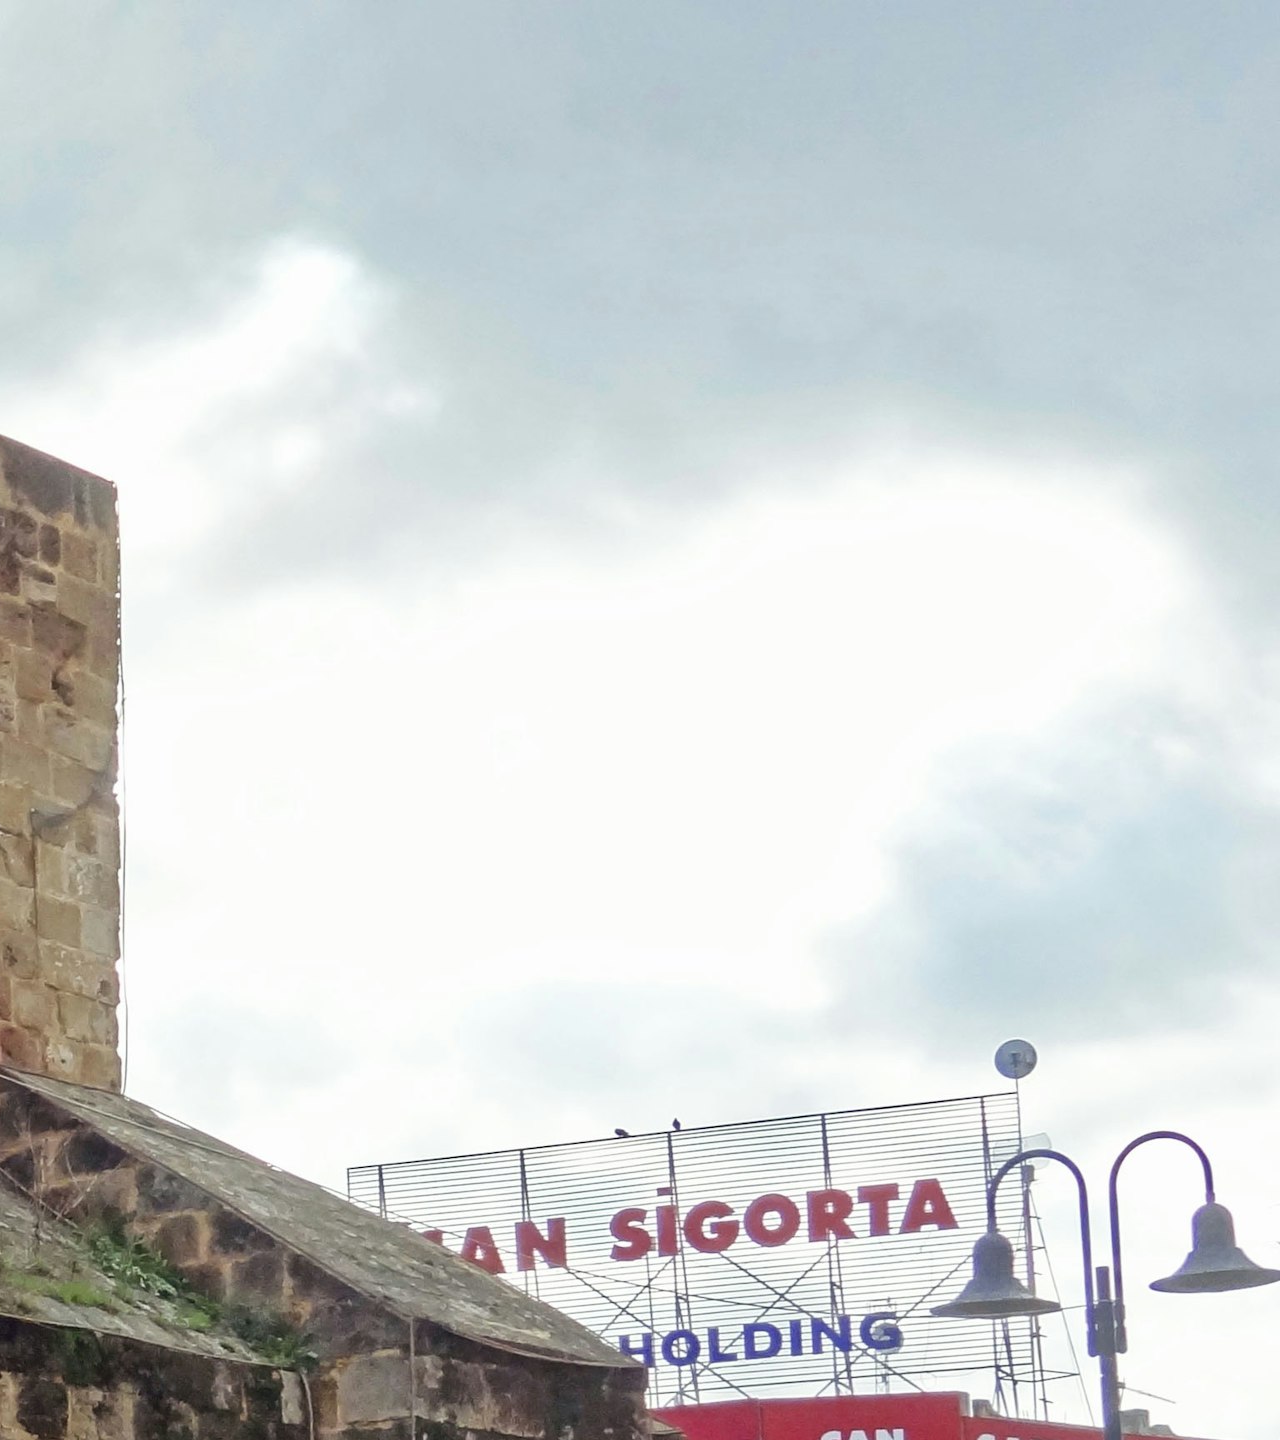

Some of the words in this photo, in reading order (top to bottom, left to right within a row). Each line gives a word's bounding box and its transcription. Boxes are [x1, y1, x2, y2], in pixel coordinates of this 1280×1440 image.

[421, 1216, 567, 1275] AN
[610, 1178, 959, 1261] SİGORTA
[619, 1311, 904, 1368] HOLDING
